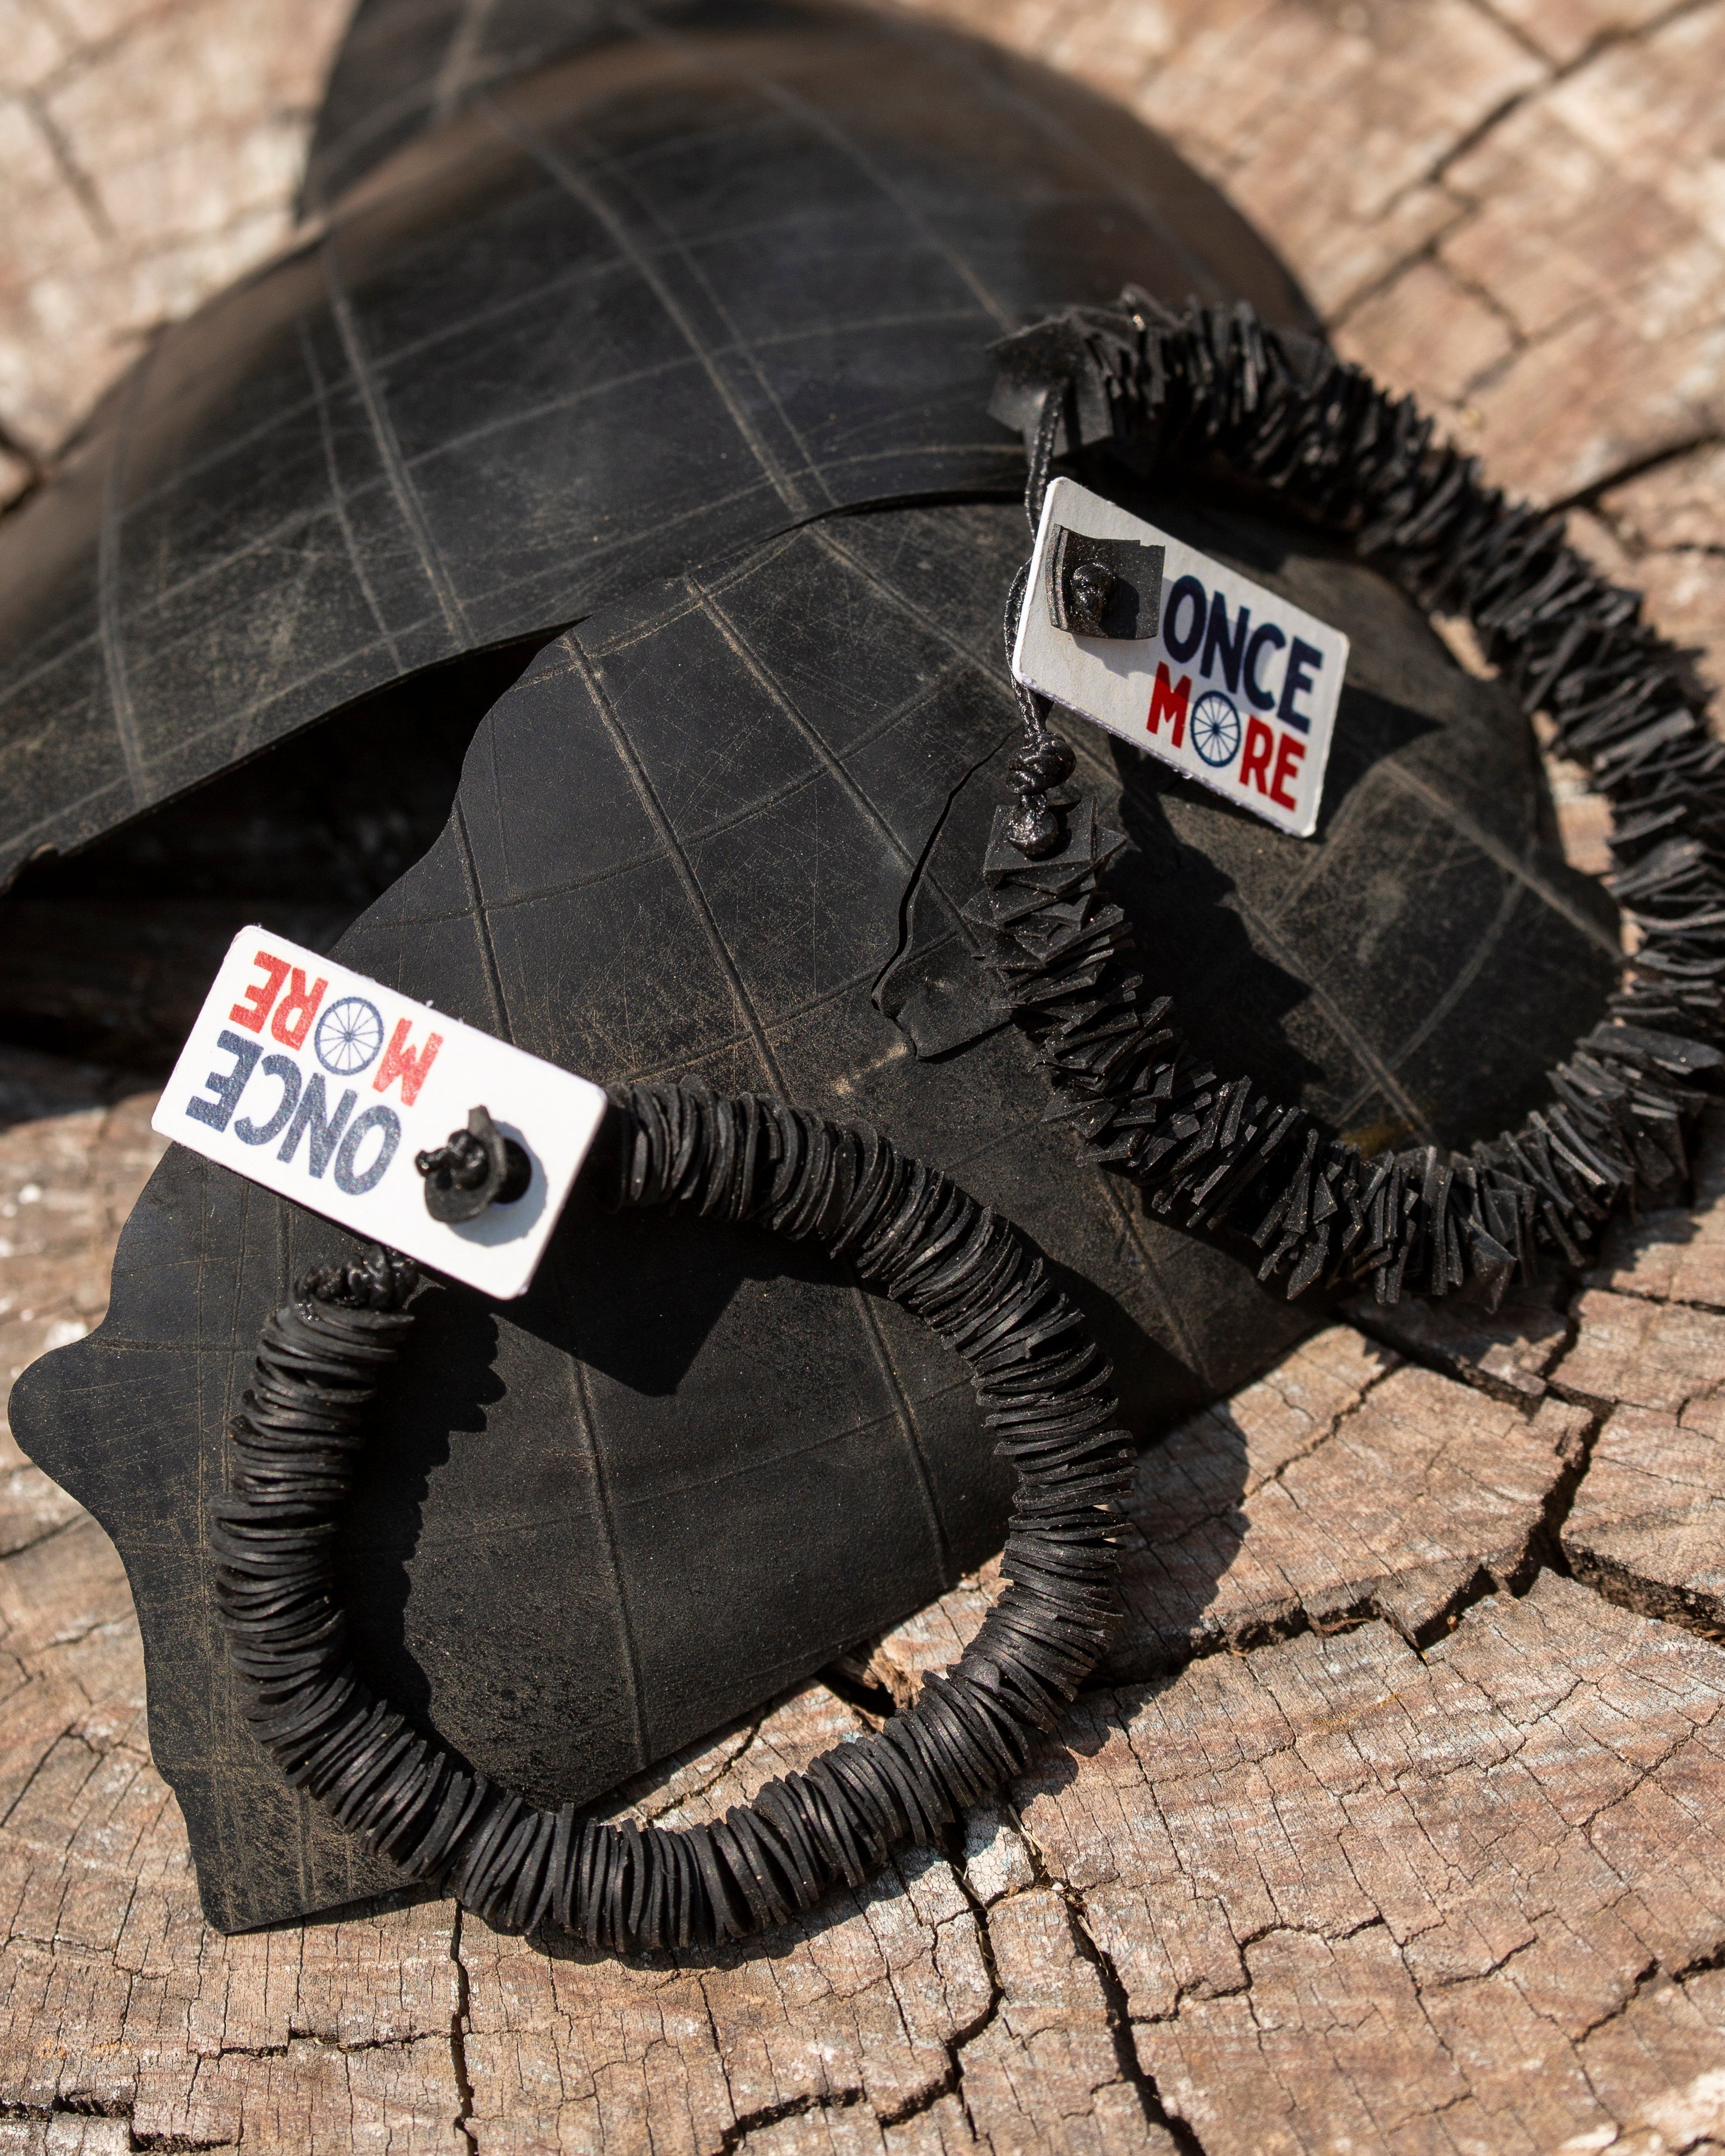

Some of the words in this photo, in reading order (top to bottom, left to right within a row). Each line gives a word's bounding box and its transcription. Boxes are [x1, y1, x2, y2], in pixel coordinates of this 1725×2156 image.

[1163, 575, 1323, 735] ONCE
[1146, 661, 1307, 812] MORE
[228, 950, 443, 1107] MORE
[185, 1030, 402, 1195] ONCE
